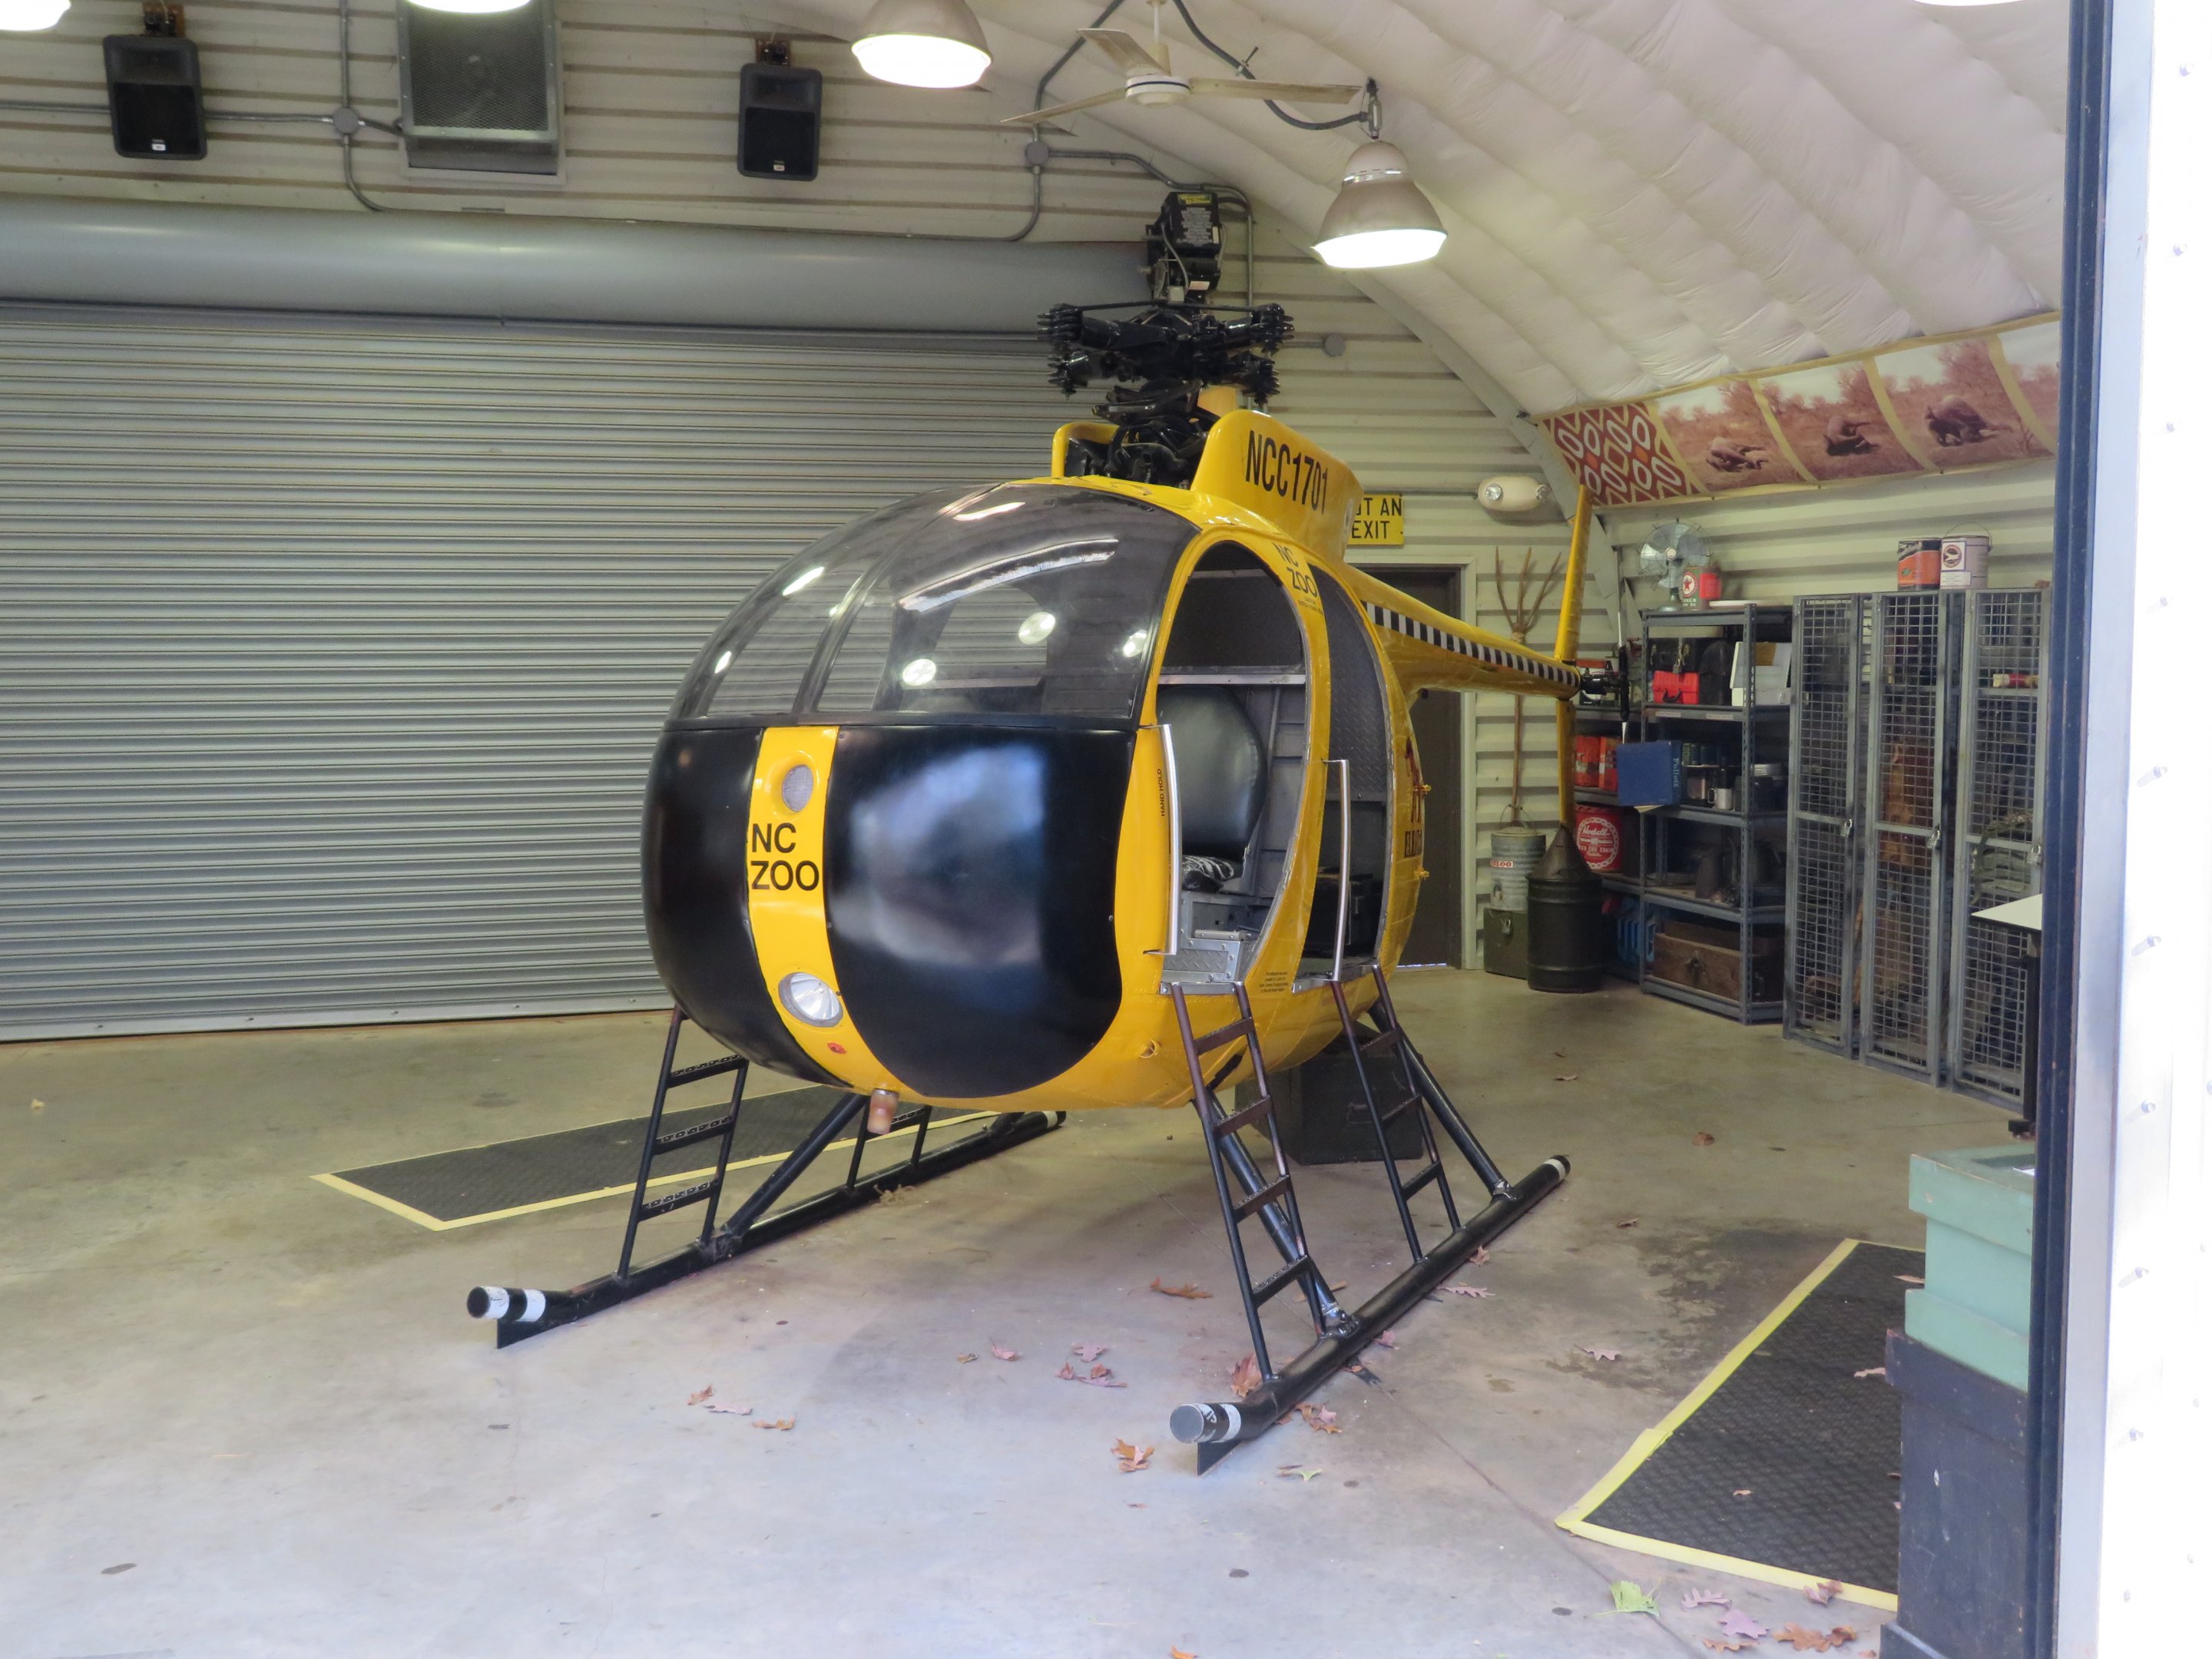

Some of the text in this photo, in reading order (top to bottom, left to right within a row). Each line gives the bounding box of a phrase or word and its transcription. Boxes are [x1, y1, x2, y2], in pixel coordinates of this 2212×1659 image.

[1245, 429, 1329, 515] NCC1701
[1379, 497, 1402, 517] AN
[1351, 520, 1390, 539] EXIT
[1272, 542, 1299, 568] NC
[1286, 566, 1318, 598] ZOO
[752, 823, 796, 853] NC
[750, 859, 820, 891] ZOO
